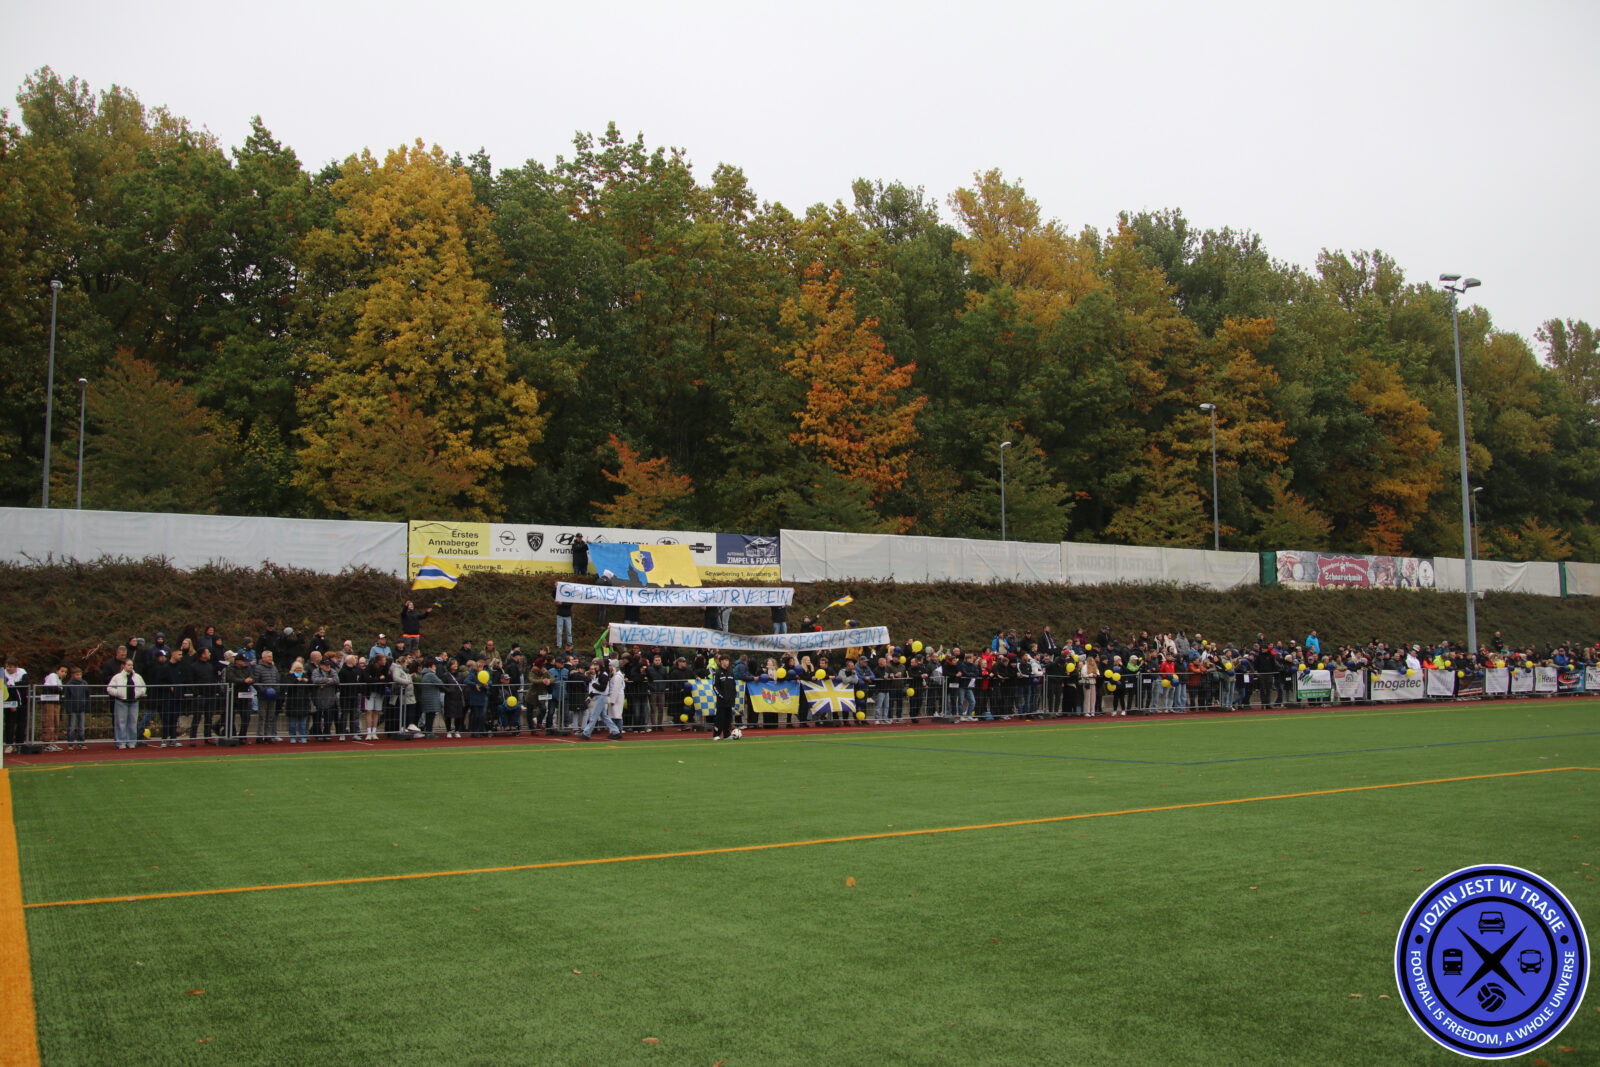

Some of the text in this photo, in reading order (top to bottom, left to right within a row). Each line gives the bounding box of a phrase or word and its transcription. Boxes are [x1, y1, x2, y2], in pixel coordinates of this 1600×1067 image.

[452, 531, 479, 539] Erstes
[428, 539, 479, 548] Annaberger
[437, 547, 479, 555] Autohaus
[727, 556, 749, 564] ZIMPEL
[731, 589, 740, 604] &
[742, 590, 790, 604] VEREIN
[619, 627, 676, 644] WERDEN
[681, 631, 708, 645] WIR
[711, 632, 756, 649] GEGEN
[1373, 678, 1421, 691] mogatec
